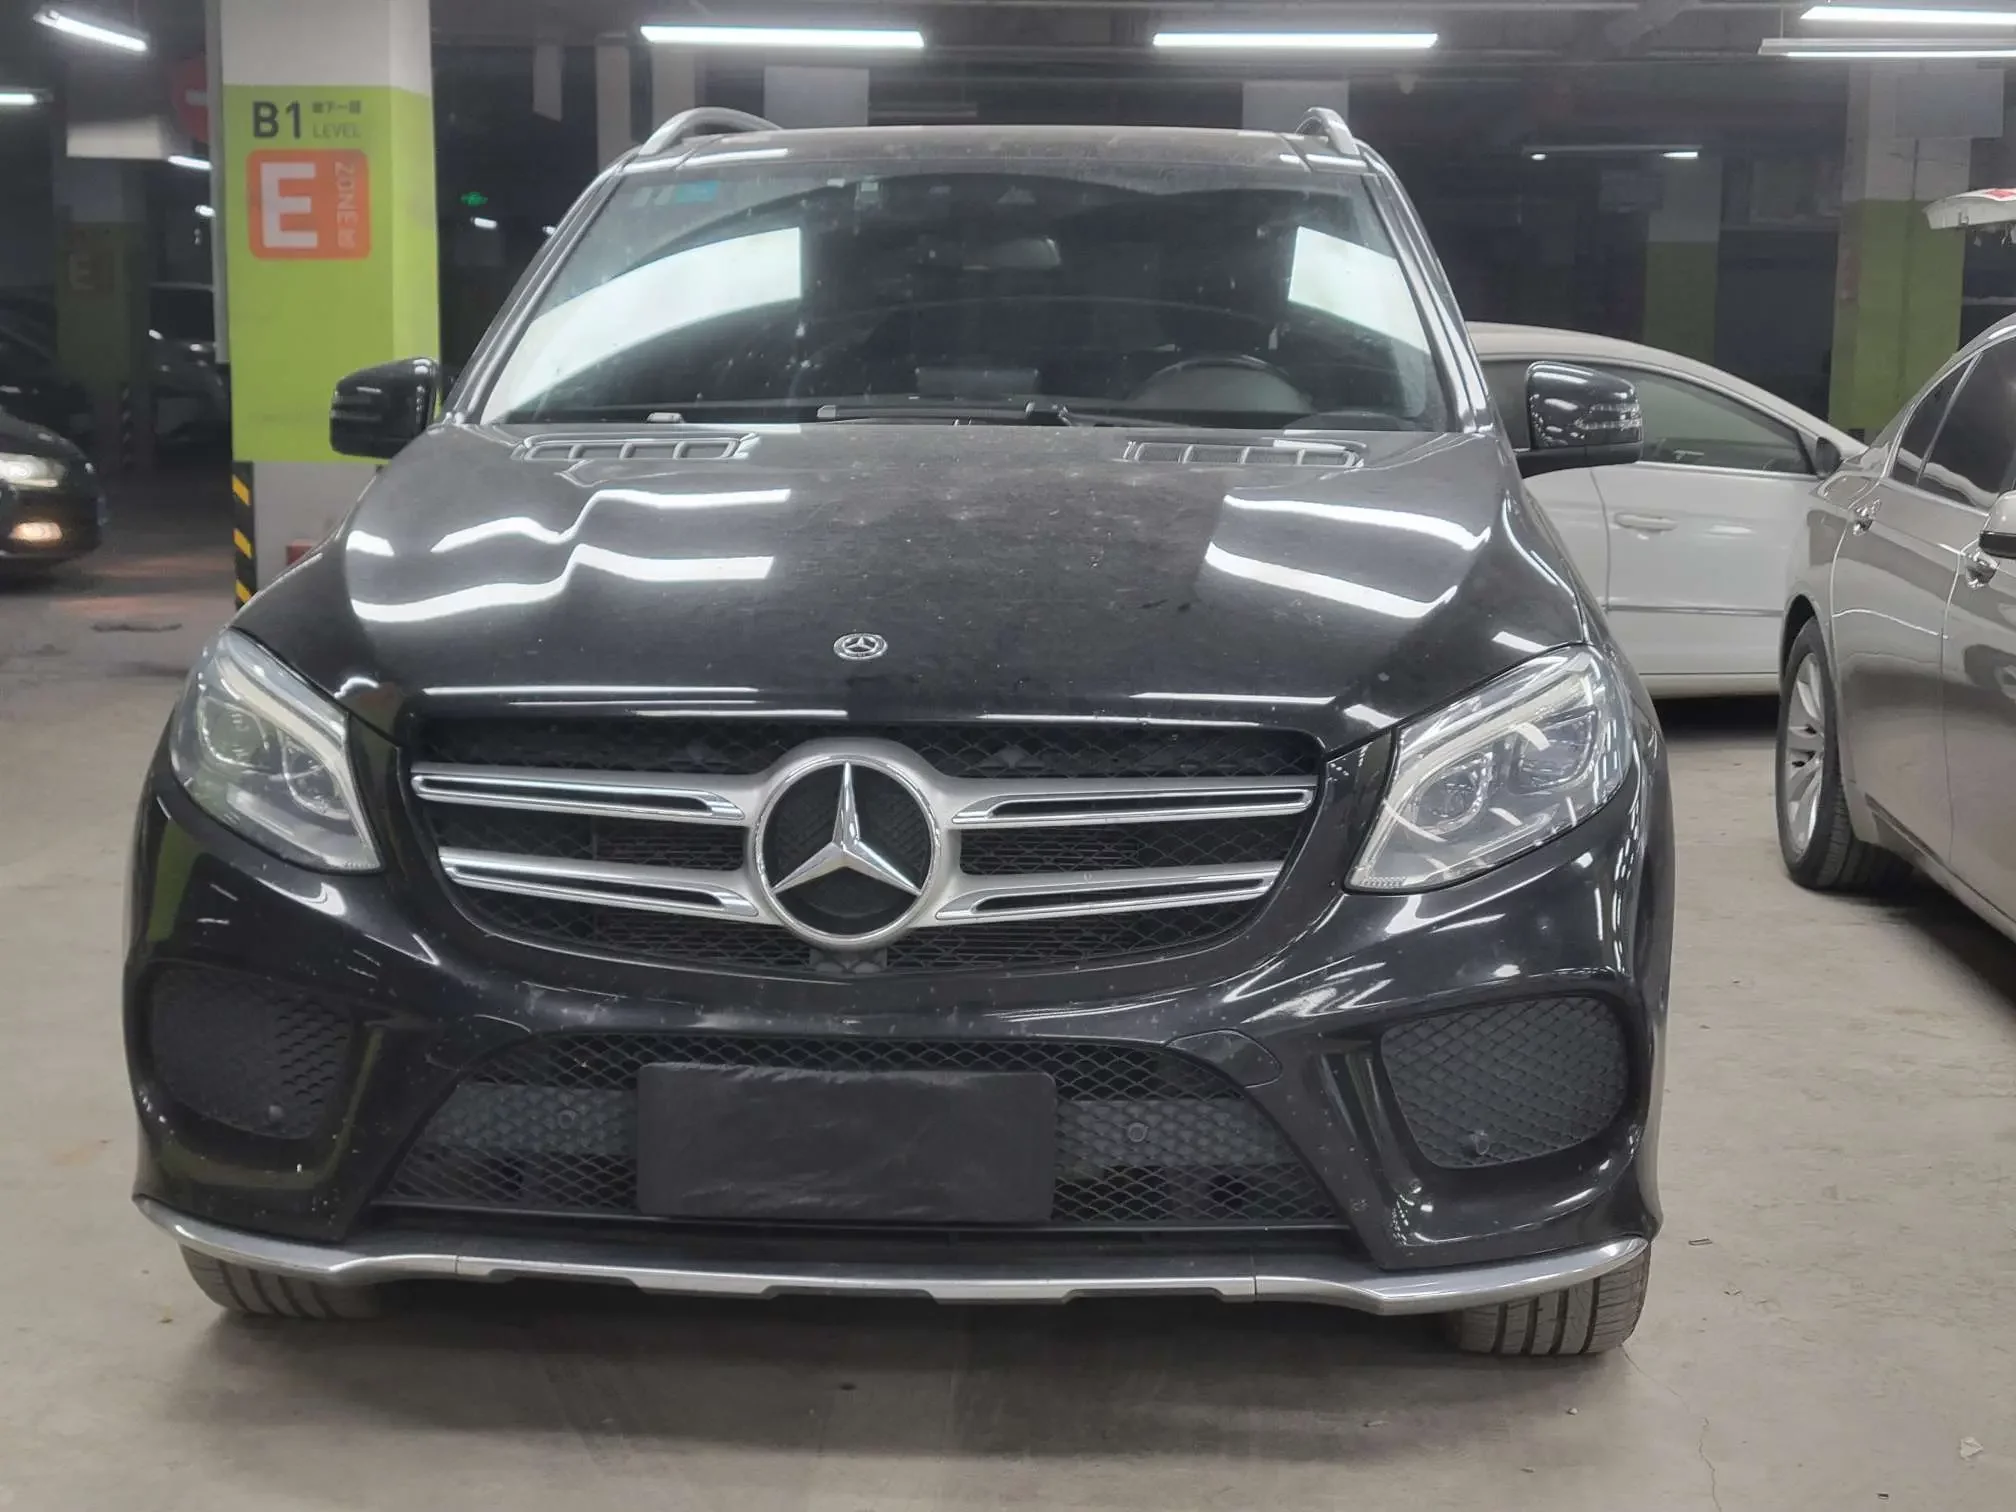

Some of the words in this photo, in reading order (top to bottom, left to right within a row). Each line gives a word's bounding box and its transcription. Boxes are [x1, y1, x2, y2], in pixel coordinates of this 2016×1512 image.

[253, 101, 301, 139] B1
[312, 123, 361, 138] LEVEL
[260, 163, 317, 248] E
